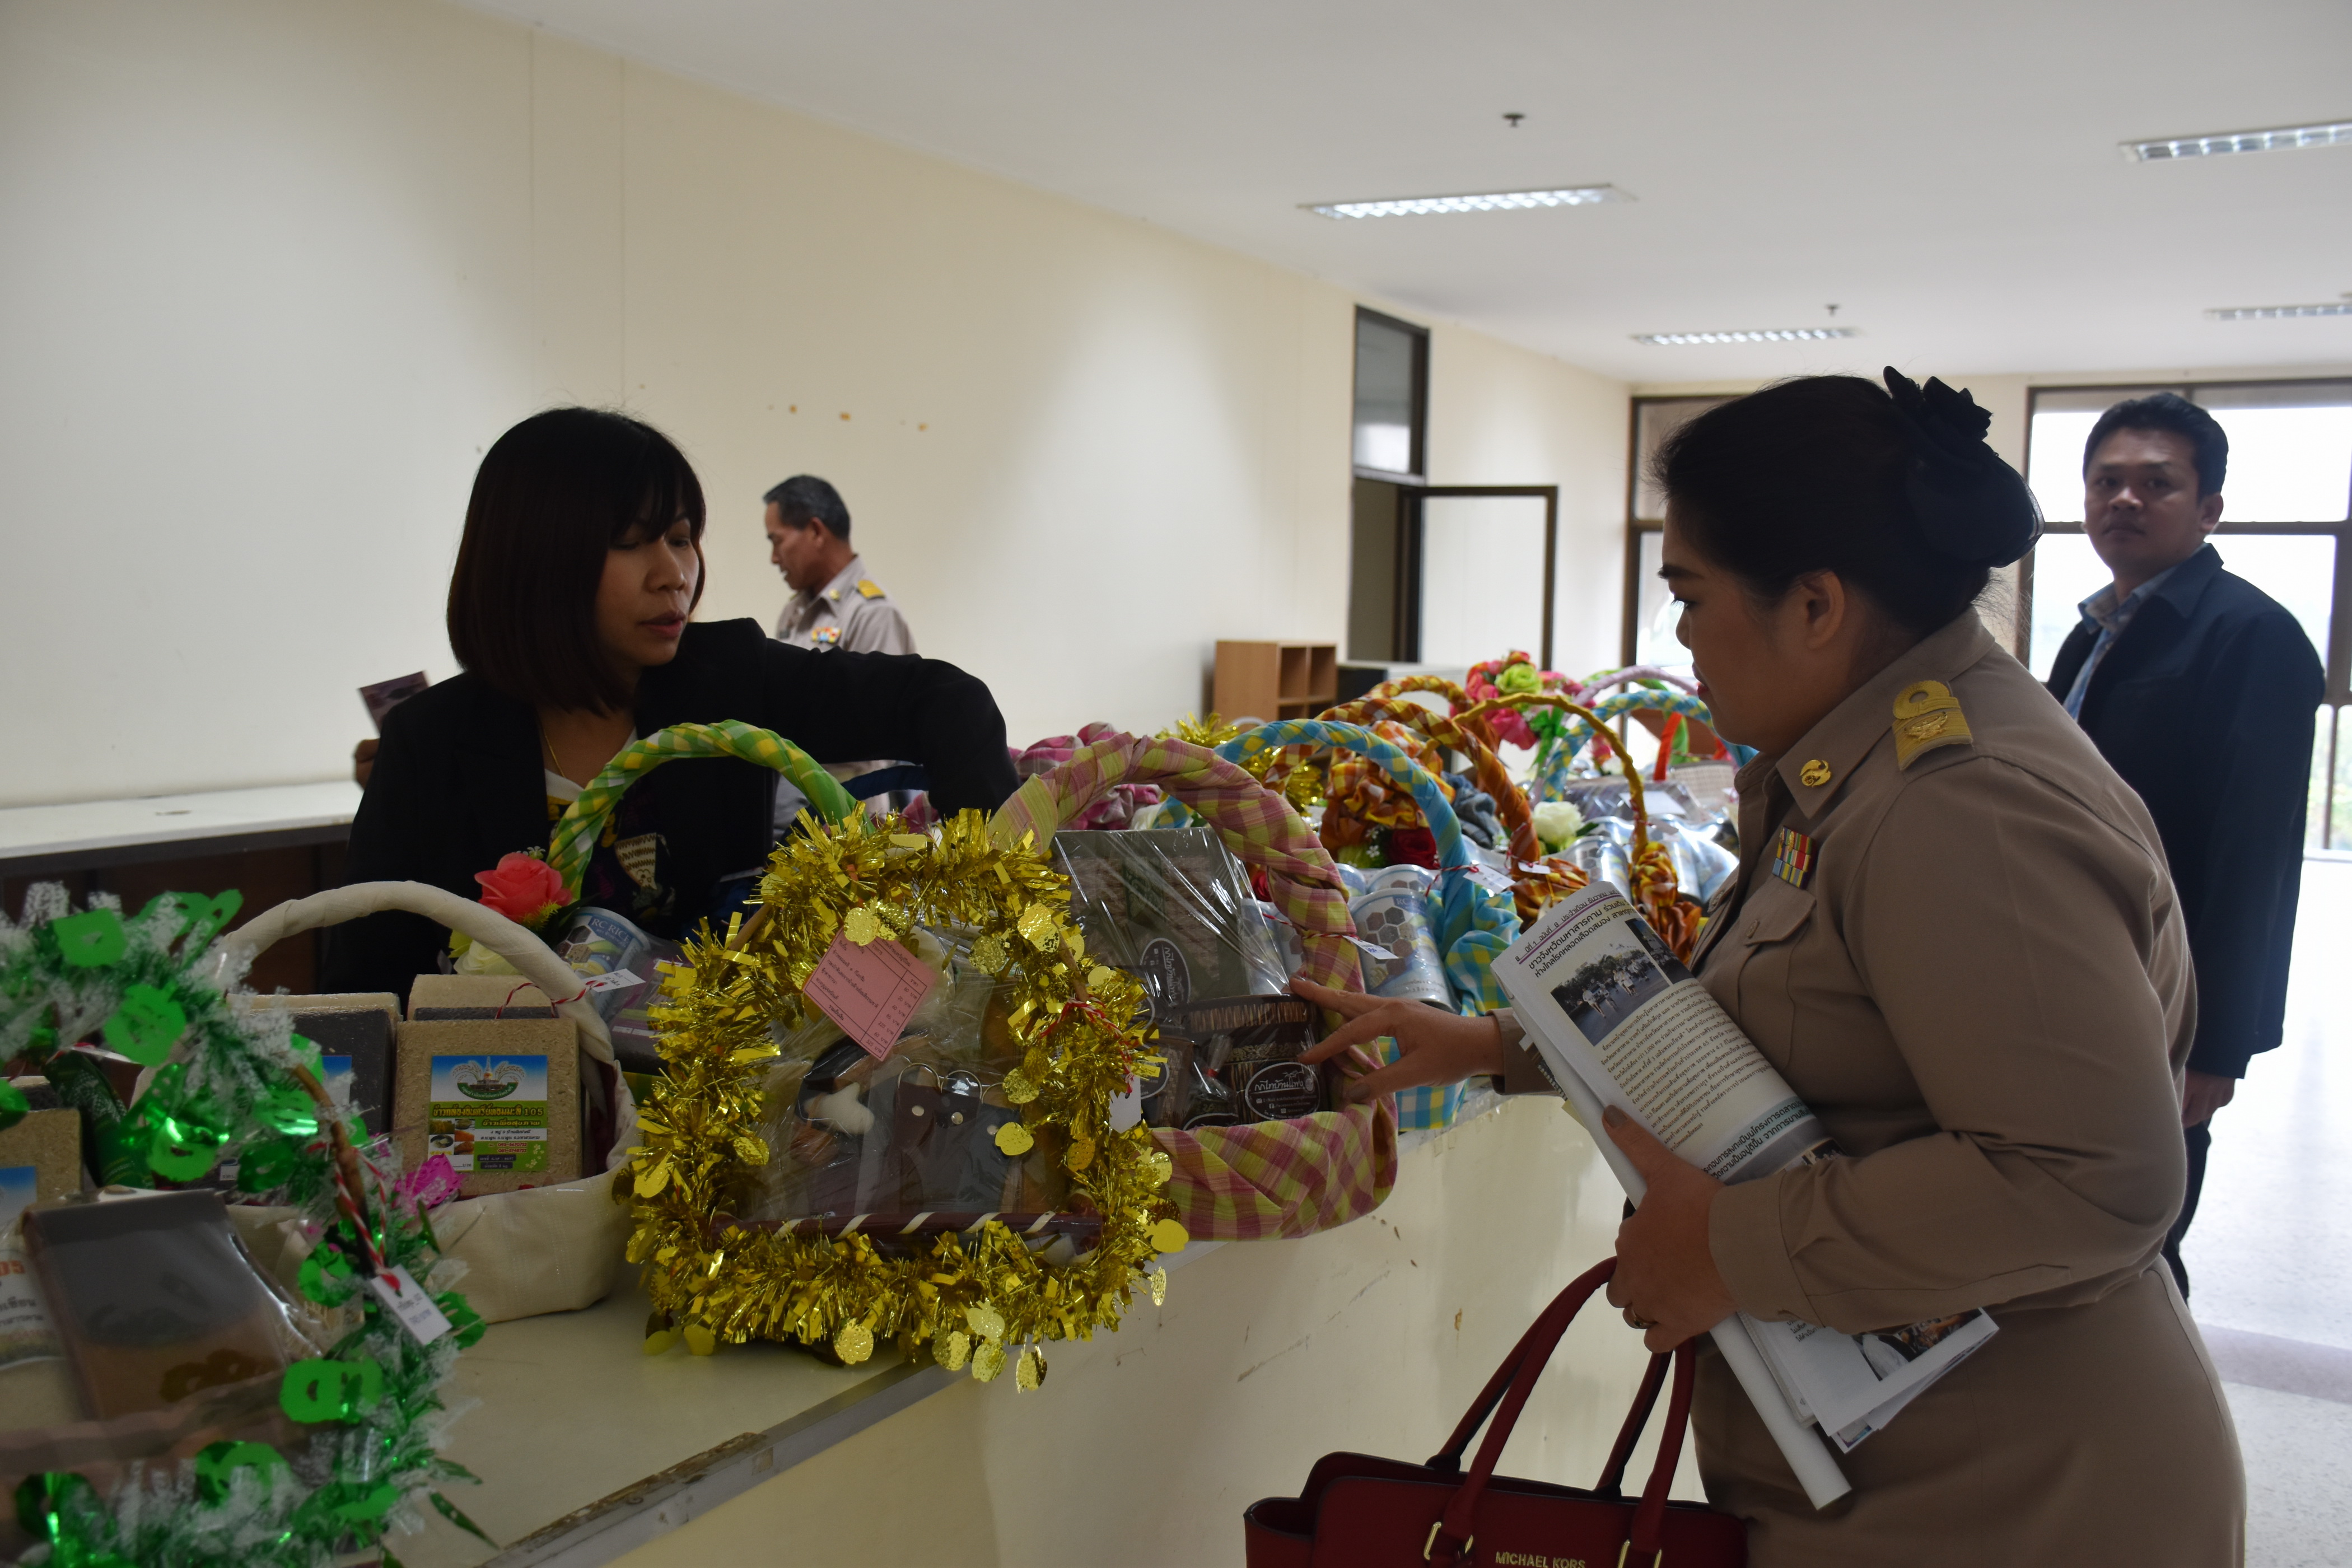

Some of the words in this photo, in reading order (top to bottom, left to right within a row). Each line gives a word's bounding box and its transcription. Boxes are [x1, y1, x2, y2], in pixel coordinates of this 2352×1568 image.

[591, 917, 608, 929] RC
[608, 923, 632, 942] RICE
[1523, 942, 1532, 953] ปีที่
[1537, 925, 1552, 941] ฉบับที่
[1561, 900, 1587, 922] ประจำเดือน
[1587, 891, 1607, 903] ธันวาคม
[1528, 908, 1602, 969] ชาวจังหวัดมหาสารคาม
[1603, 899, 1625, 912] ร่วมเดิน
[1534, 914, 1611, 978] ห่างไกลโรคหลอดเลือดสมอง
[909, 992, 918, 1000] บาท
[1661, 1006, 1670, 1014] และ
[1709, 1030, 1724, 1042] จังหวัด
[1644, 1043, 1655, 1054] 1,000
[1696, 1048, 1715, 1063] ระยะทาง
[483, 1118, 542, 1128] ข้าวเพื่อสุขภาพ
[1495, 1551, 1548, 1568] MICHAEL
[1552, 1557, 1585, 1568] KORS
